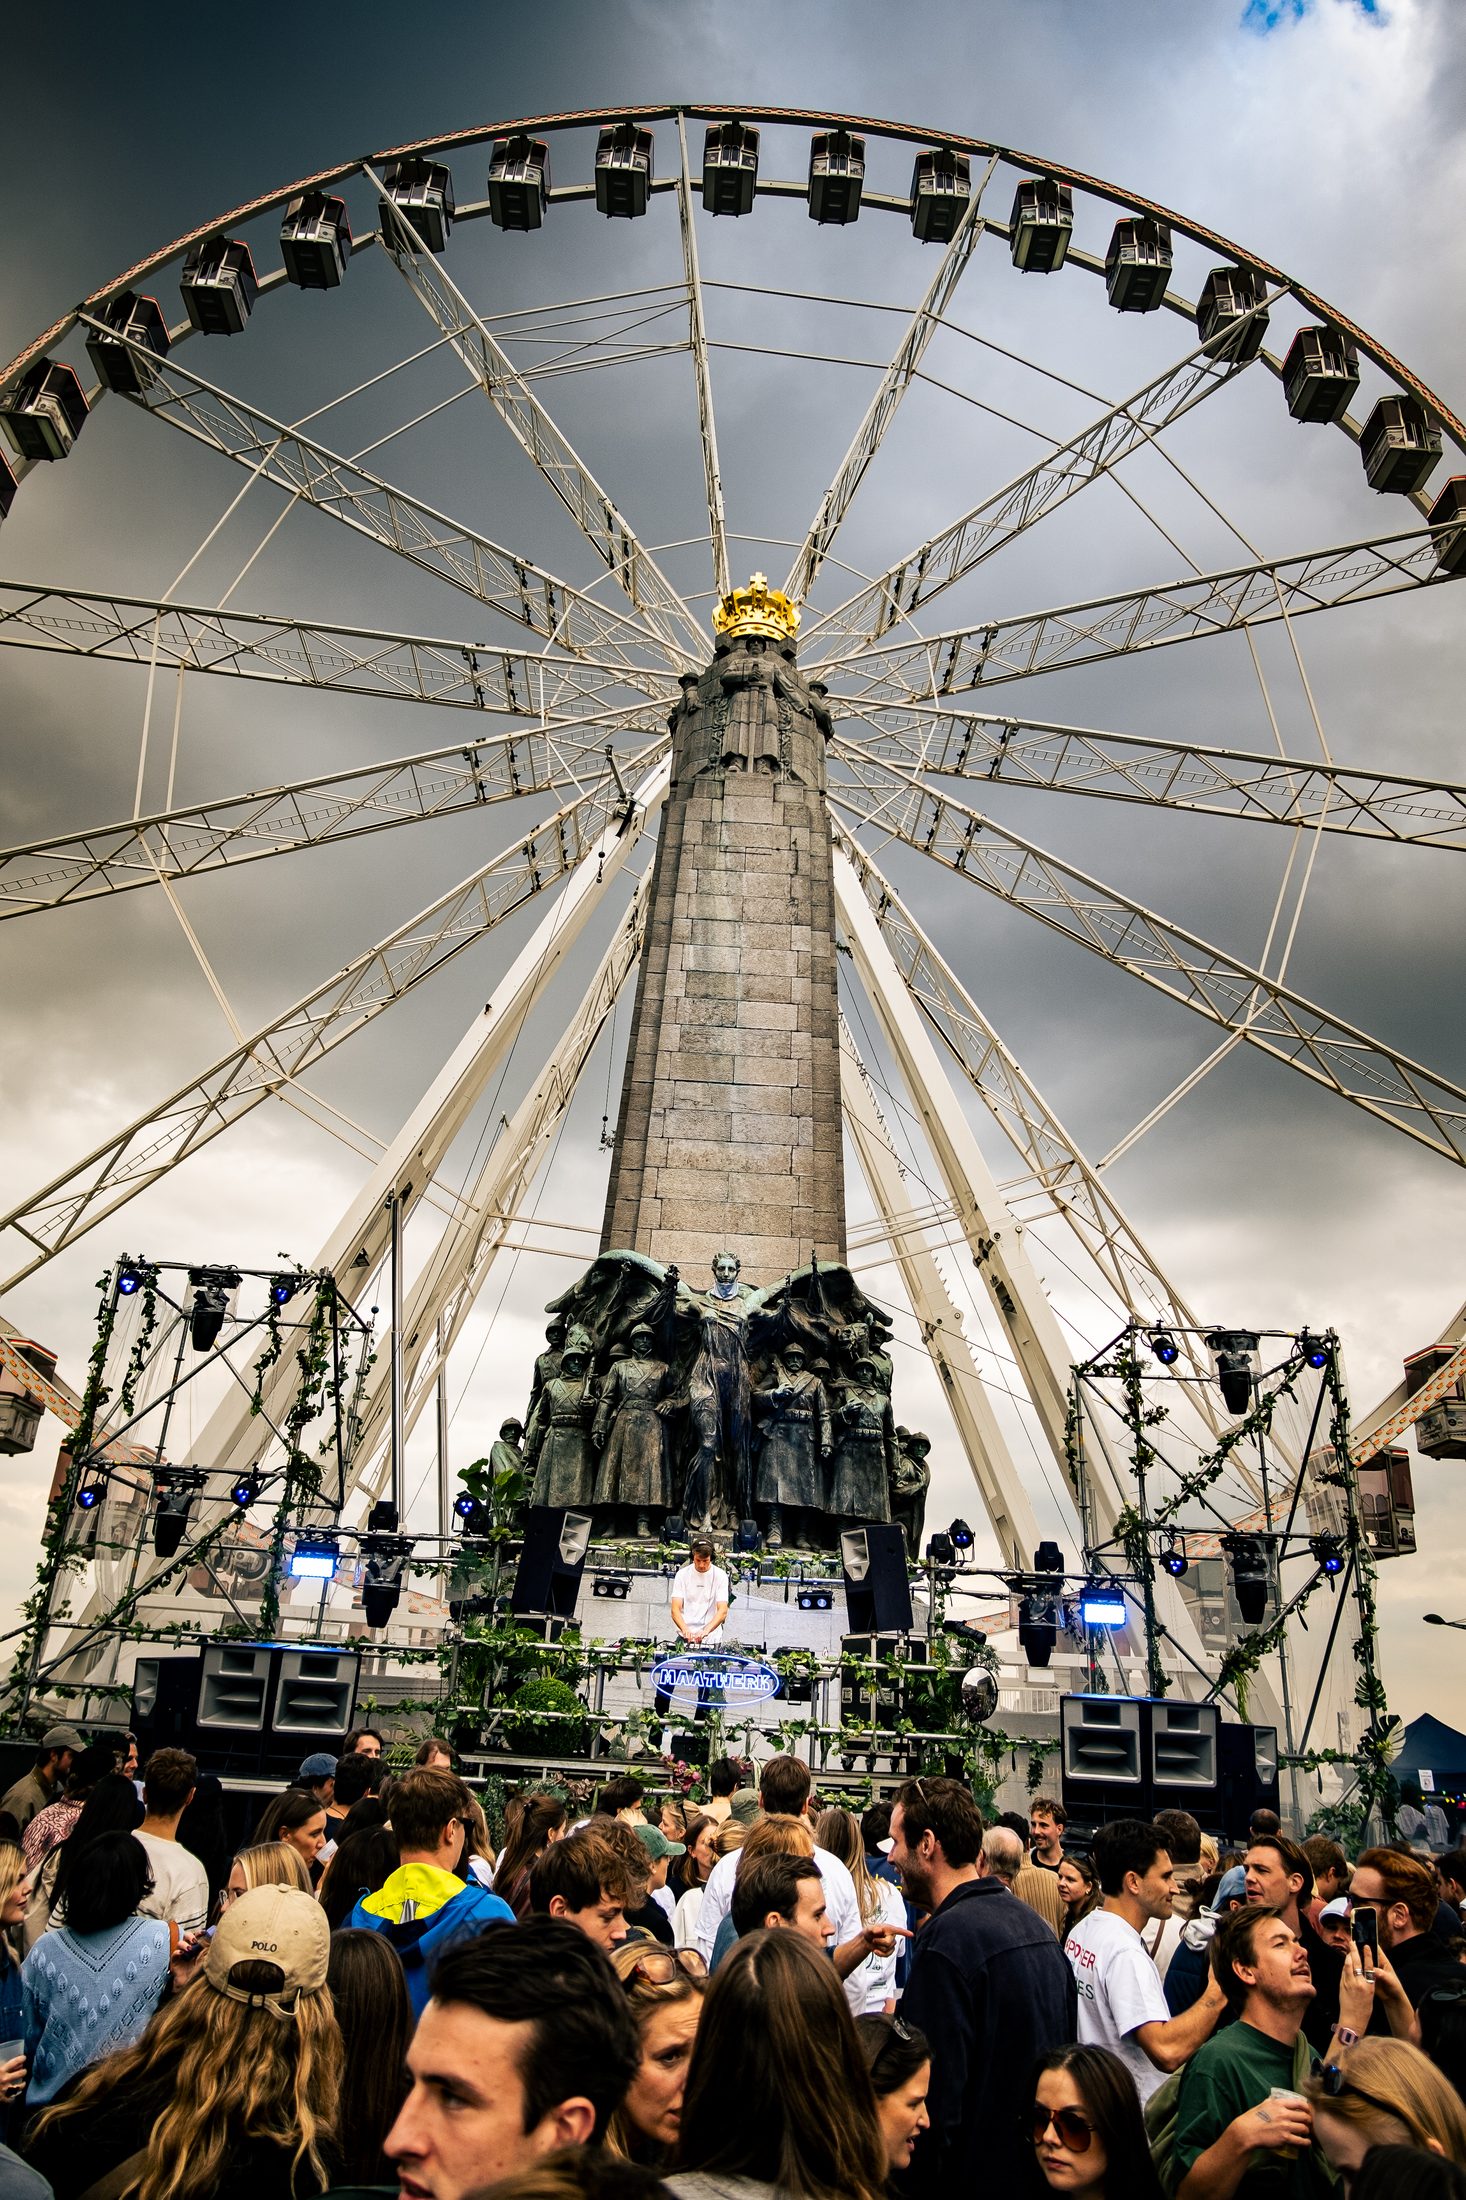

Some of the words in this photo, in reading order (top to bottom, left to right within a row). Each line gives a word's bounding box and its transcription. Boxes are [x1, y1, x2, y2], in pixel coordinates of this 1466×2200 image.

[660, 1669, 773, 1690] MAATWERK
[251, 1941, 278, 1952] POLO
[1076, 1980, 1094, 2000] ES
